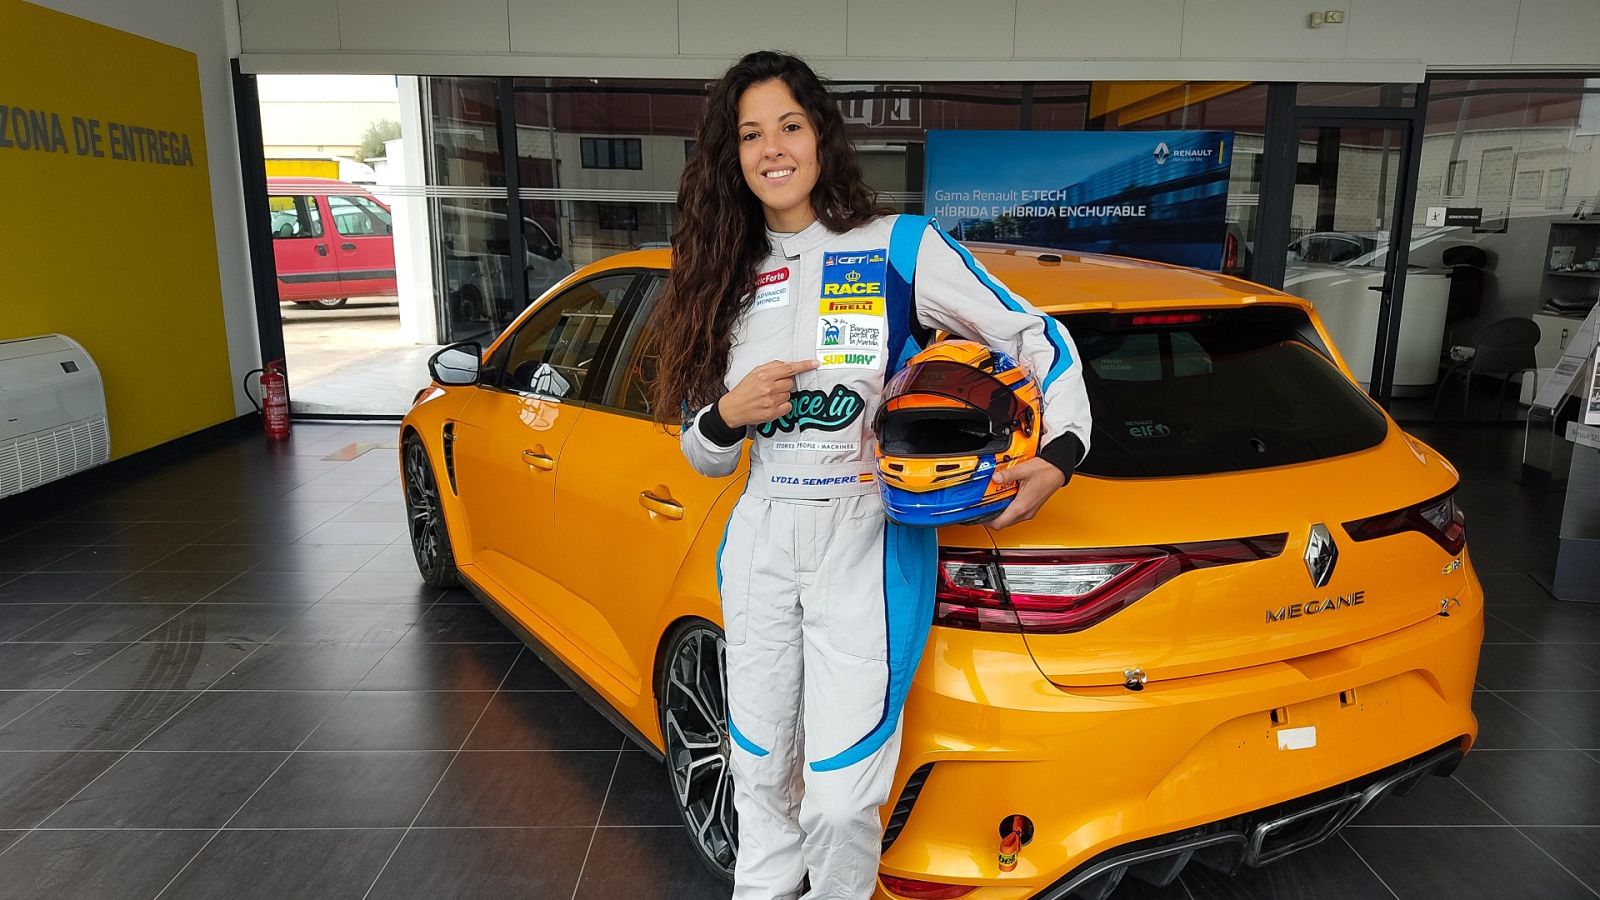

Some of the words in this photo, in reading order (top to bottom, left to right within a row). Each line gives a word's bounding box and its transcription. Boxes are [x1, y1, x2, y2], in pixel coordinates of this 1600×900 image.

[0, 105, 69, 154] ZONA
[72, 116, 104, 158] DE
[108, 122, 194, 167] ENTREGA
[1173, 149, 1213, 157] RENAULT
[934, 190, 970, 202] Gama
[973, 190, 1017, 201] Renault
[1021, 190, 1067, 201] E-TECH
[934, 204, 988, 217] HÍBRIDA
[992, 206, 999, 217] E
[1002, 204, 1056, 217] HÍBRIDA
[1060, 205, 1146, 217] ENCHUFABLE
[838, 256, 866, 265] CET
[824, 282, 881, 295] RACE
[829, 300, 873, 311] PIRELLI
[821, 353, 876, 366] SUBWAY
[1129, 425, 1155, 437] elf
[771, 475, 800, 485] LYDIA
[801, 475, 857, 486] SEMPERE
[1265, 590, 1366, 624] MEGANE
